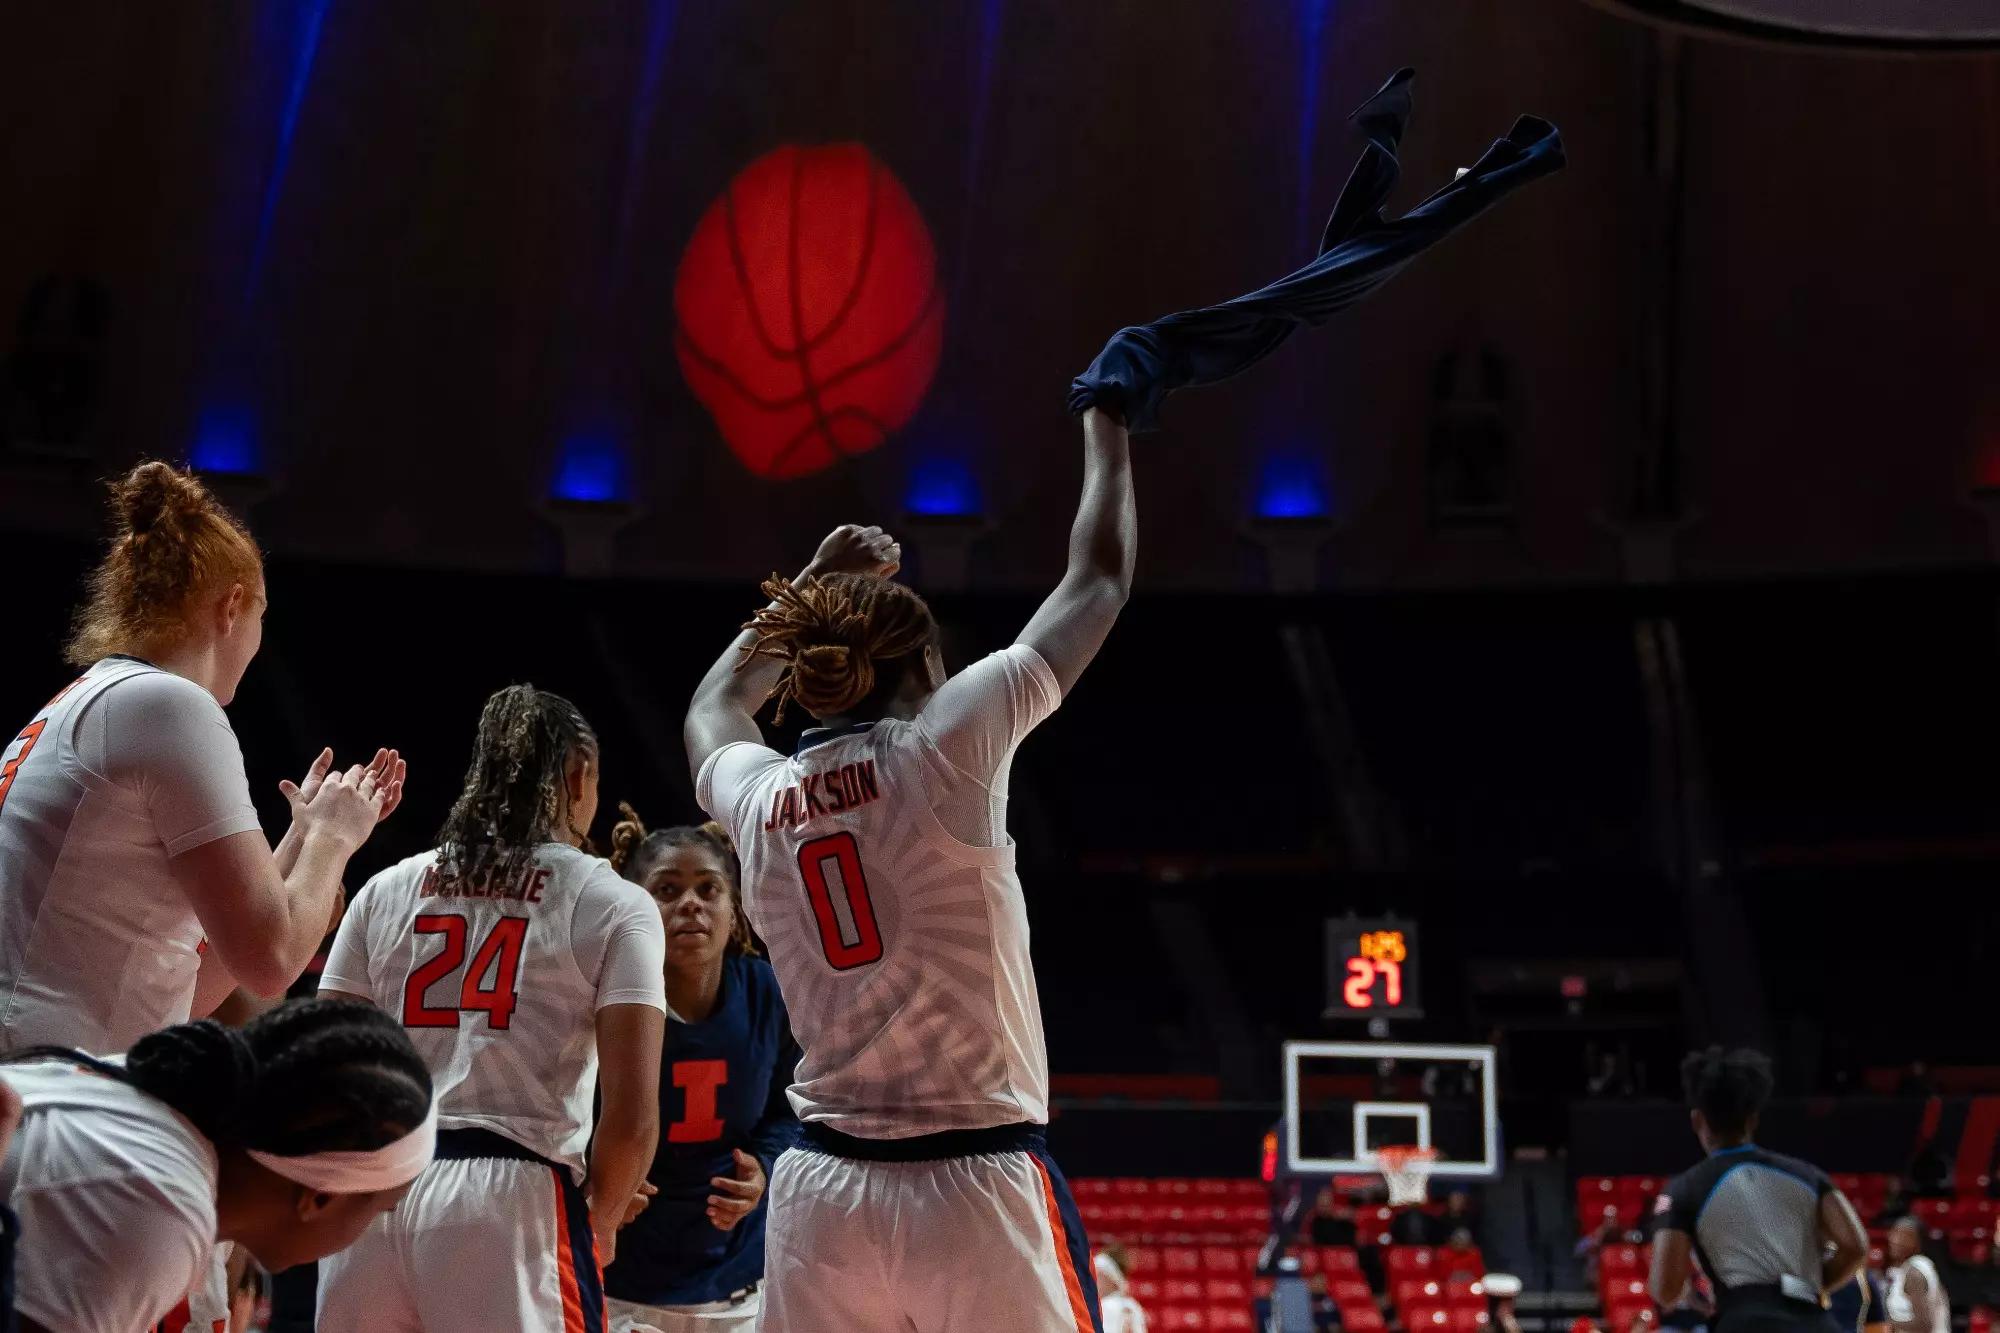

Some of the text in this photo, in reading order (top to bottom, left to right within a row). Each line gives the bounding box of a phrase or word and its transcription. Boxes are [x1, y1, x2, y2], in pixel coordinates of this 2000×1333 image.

[764, 759, 881, 832] JACKSON
[797, 831, 884, 971] 0
[403, 914, 529, 1030] 24
[1343, 957, 1401, 1007] 27
[667, 1059, 727, 1142] I
